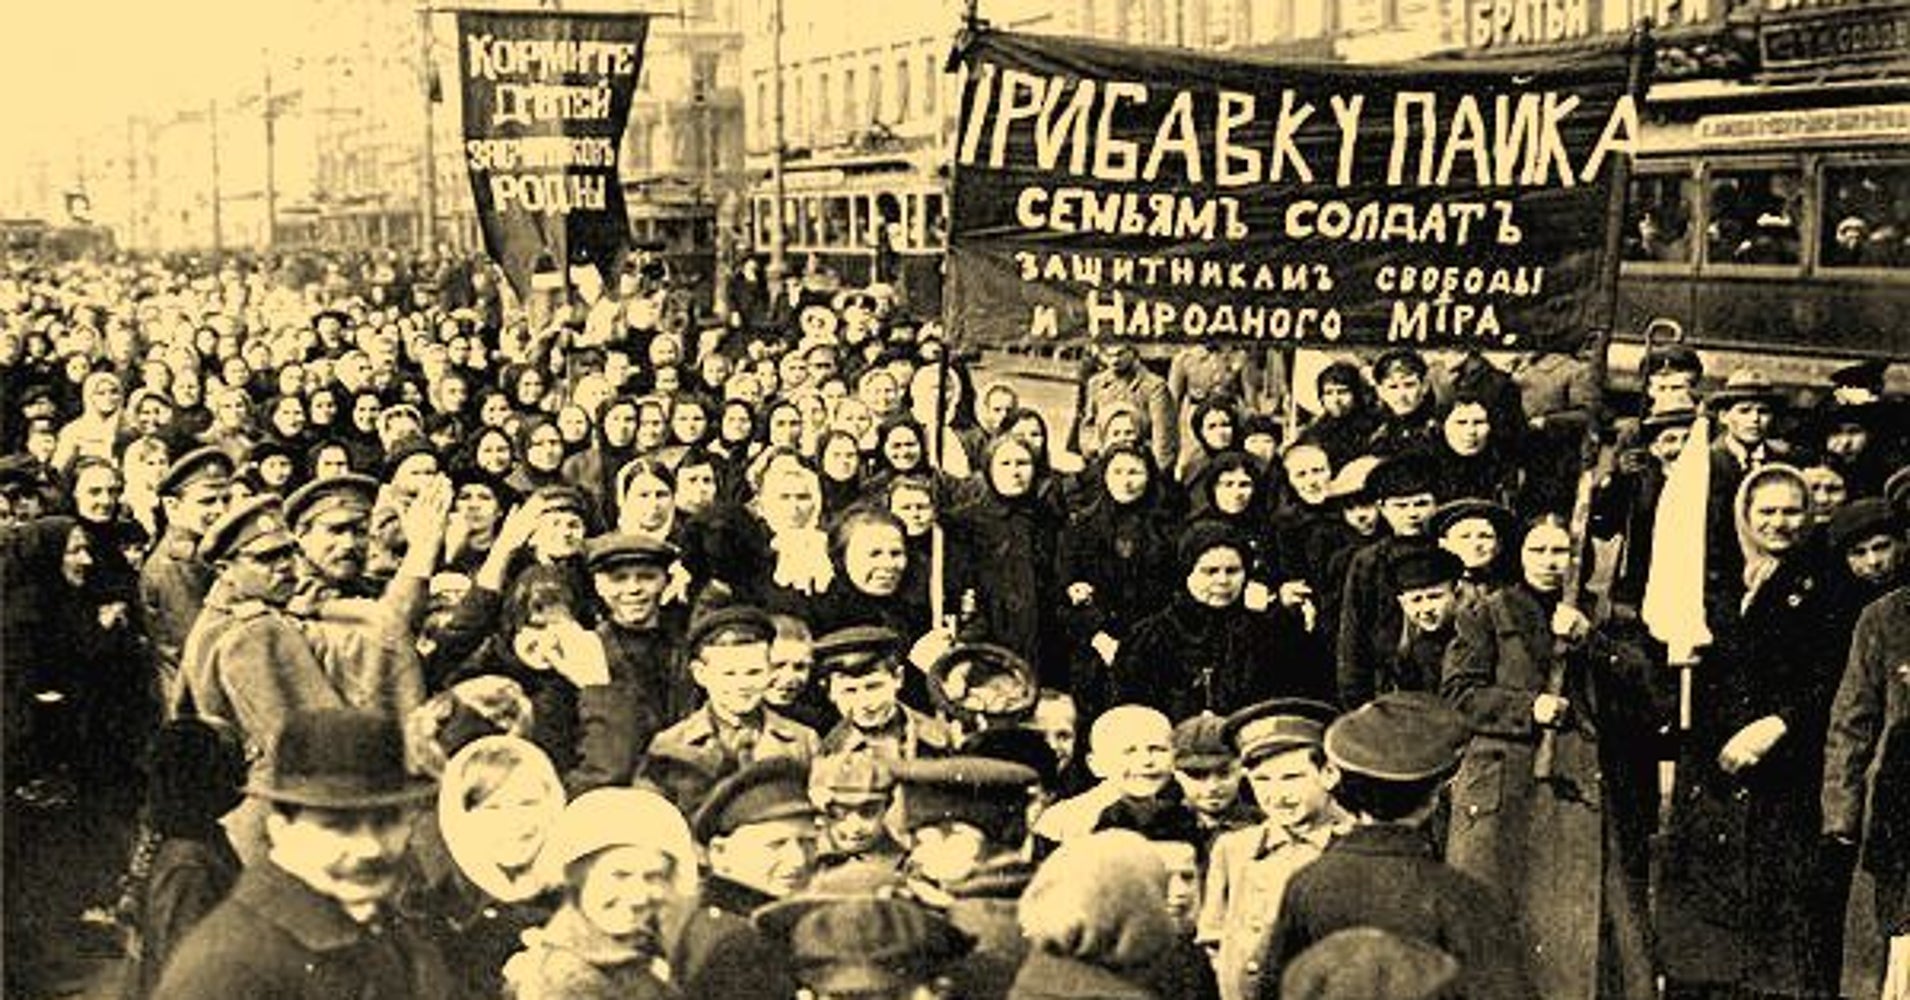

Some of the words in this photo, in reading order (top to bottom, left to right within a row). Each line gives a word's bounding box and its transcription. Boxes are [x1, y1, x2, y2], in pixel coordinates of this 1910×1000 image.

[1386, 74, 1645, 189] ПАЙКА
[1016, 186, 1250, 241] СЕМЬЯМЪ
[1285, 200, 1523, 246] СОЛДАТЪ
[1375, 265, 1546, 296] СВОБОДЫ
